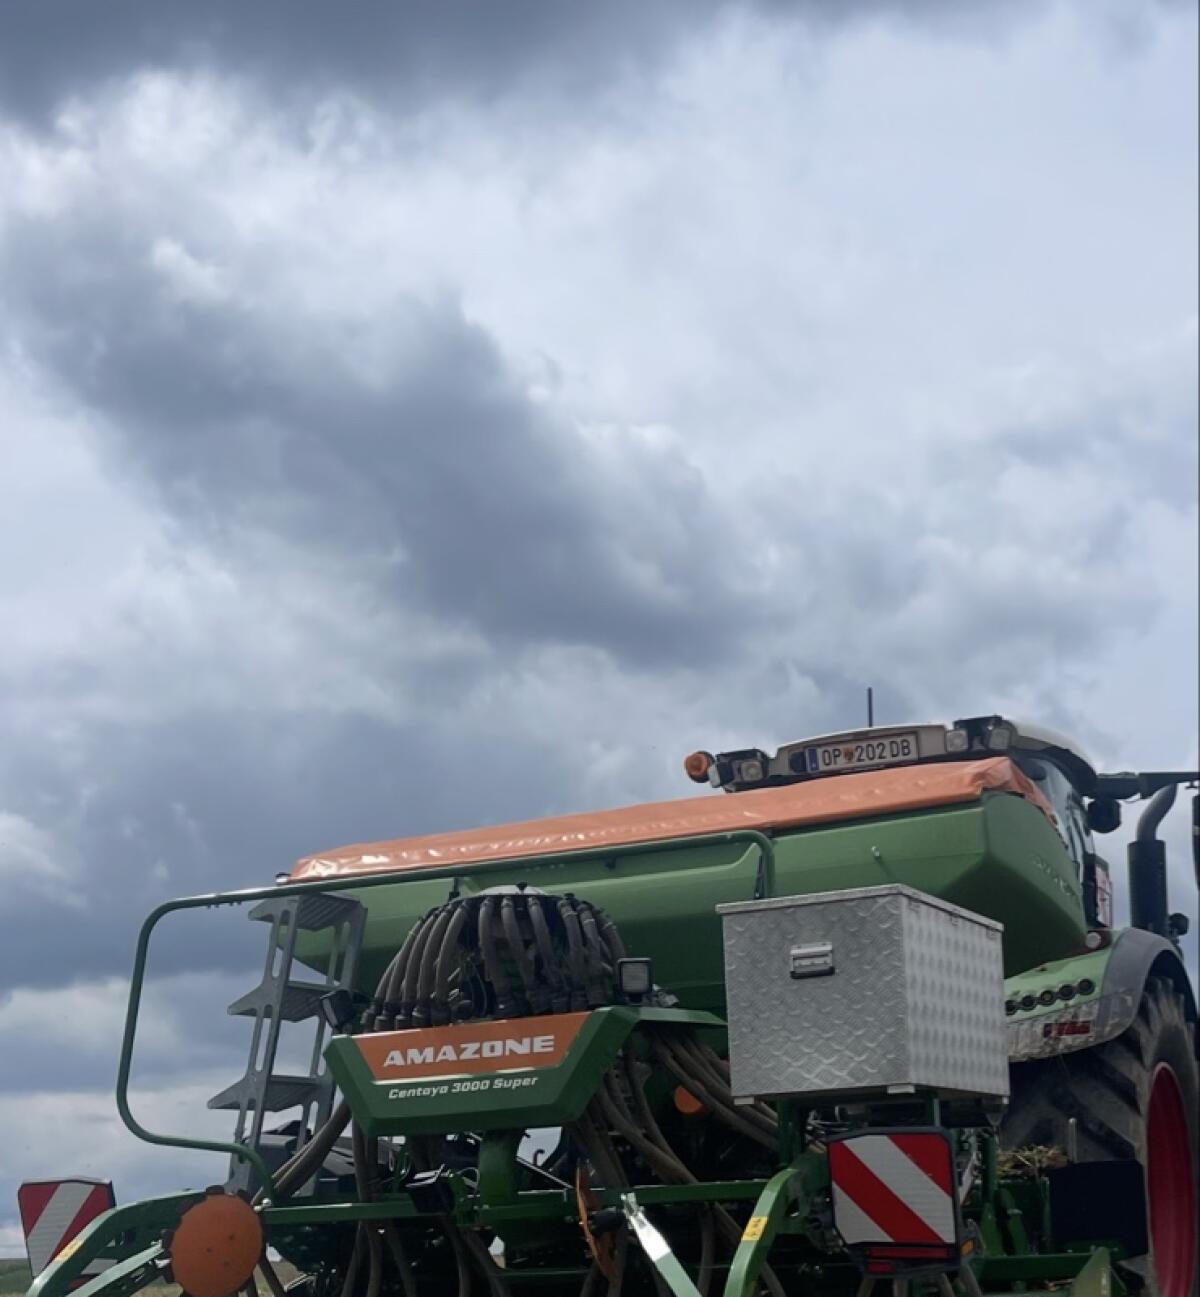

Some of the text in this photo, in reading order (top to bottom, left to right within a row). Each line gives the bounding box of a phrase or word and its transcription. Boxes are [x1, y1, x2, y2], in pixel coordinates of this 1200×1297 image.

[822, 748, 842, 766] OP
[855, 742, 886, 762] 202
[890, 739, 911, 758] DB
[383, 1035, 555, 1067] AMAZONE
[388, 1076, 539, 1100] Centaya 3000 Super
